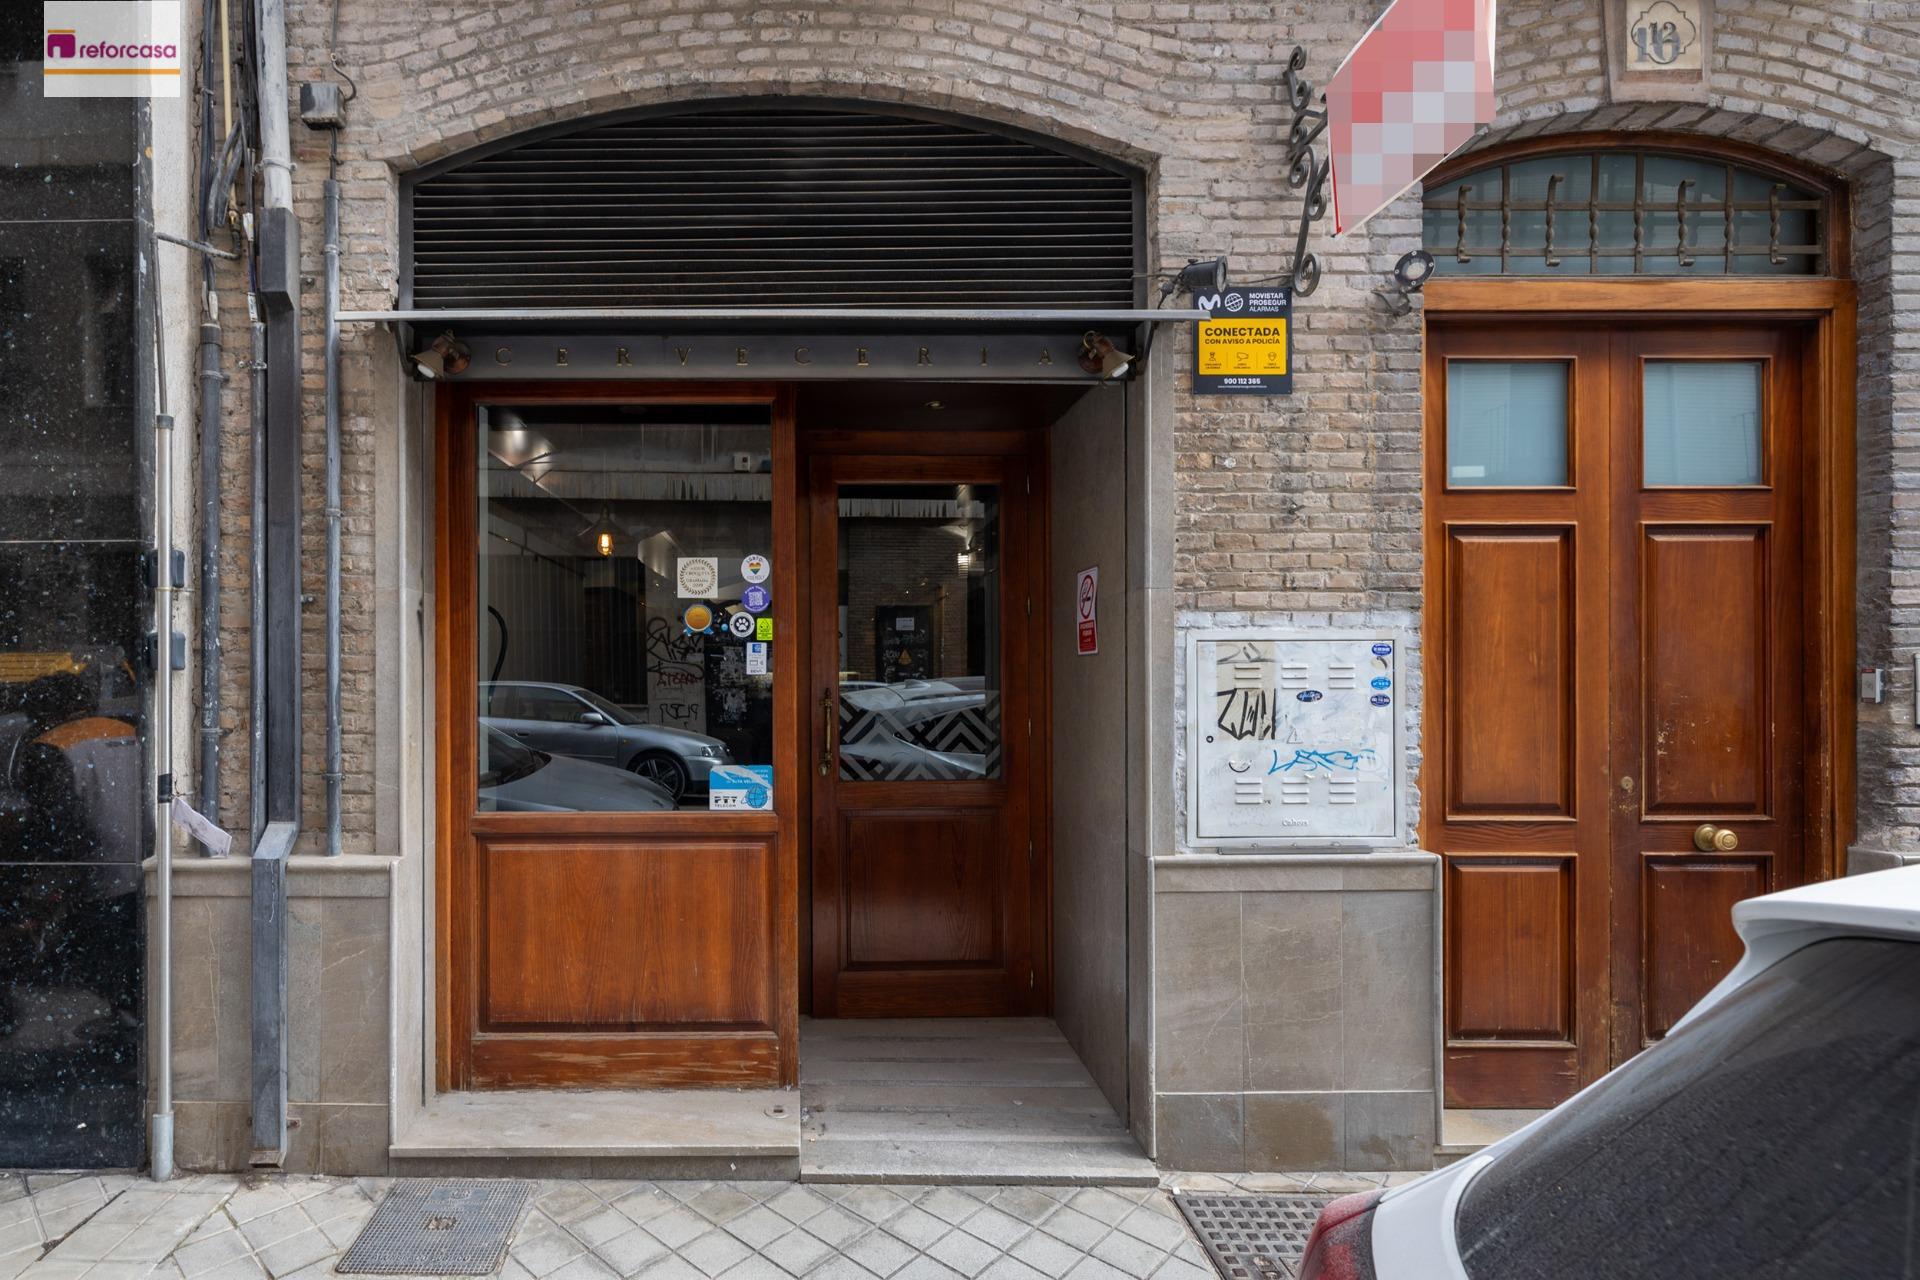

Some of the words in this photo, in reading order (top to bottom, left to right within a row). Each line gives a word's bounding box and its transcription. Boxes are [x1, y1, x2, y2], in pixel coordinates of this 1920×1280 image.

[1648, 21, 1676, 43] 12
[1205, 327, 1280, 336] CONECTADA
[1252, 336, 1280, 344] POLICÍA
[495, 347, 1053, 367] CERVECERIA
